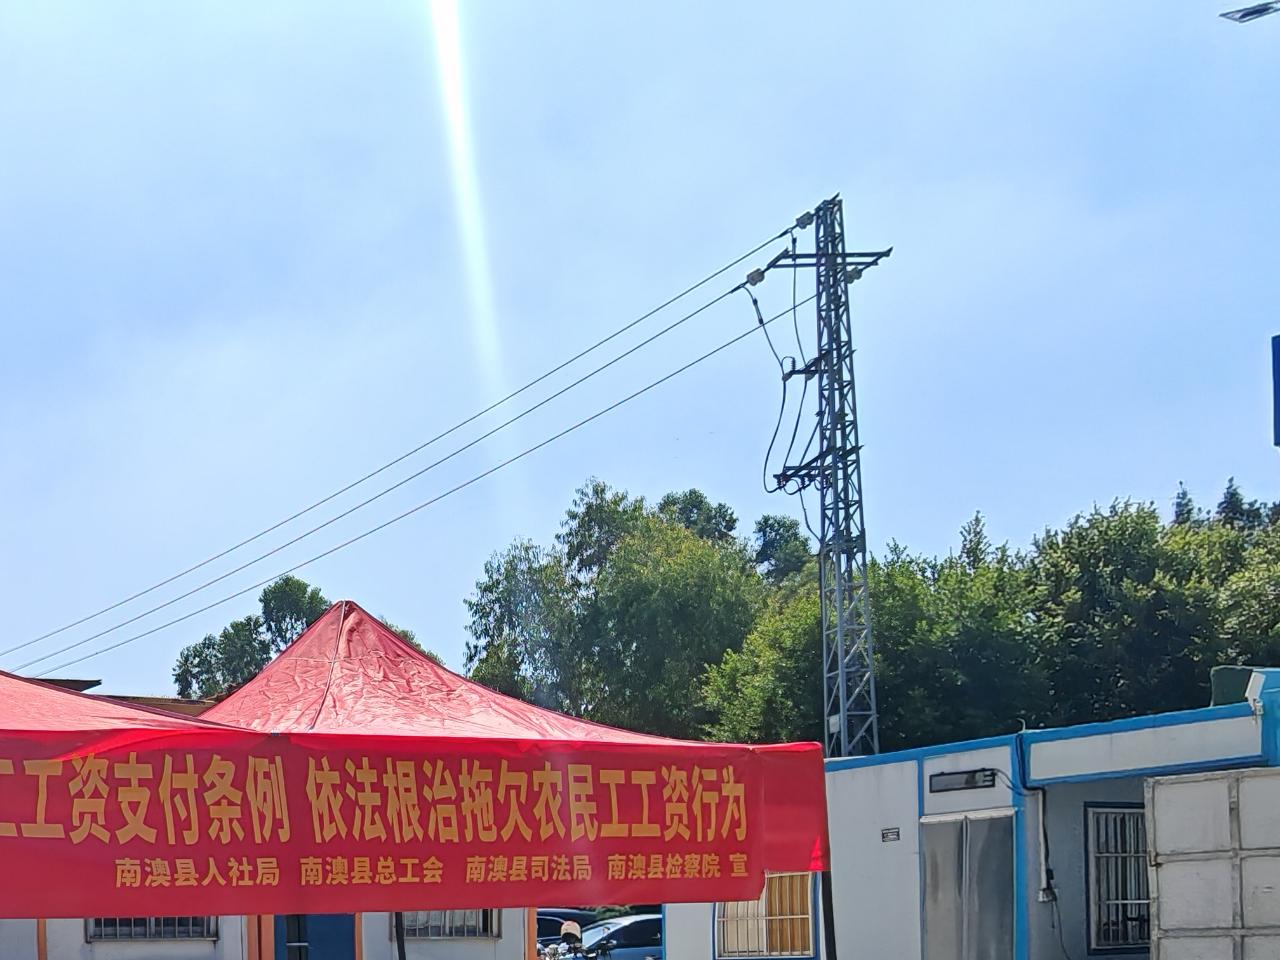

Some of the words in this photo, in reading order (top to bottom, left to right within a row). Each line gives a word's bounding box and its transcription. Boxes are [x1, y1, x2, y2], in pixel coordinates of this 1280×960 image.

[306, 755, 747, 844] 依法根治拖欠农民工工资行为
[114, 856, 280, 888] 南澳县人社局
[299, 855, 444, 886] 南澳县总工会
[465, 854, 593, 884] 南澳县司法局
[607, 852, 720, 880] 南澳县检察院
[728, 853, 749, 878] 宣
